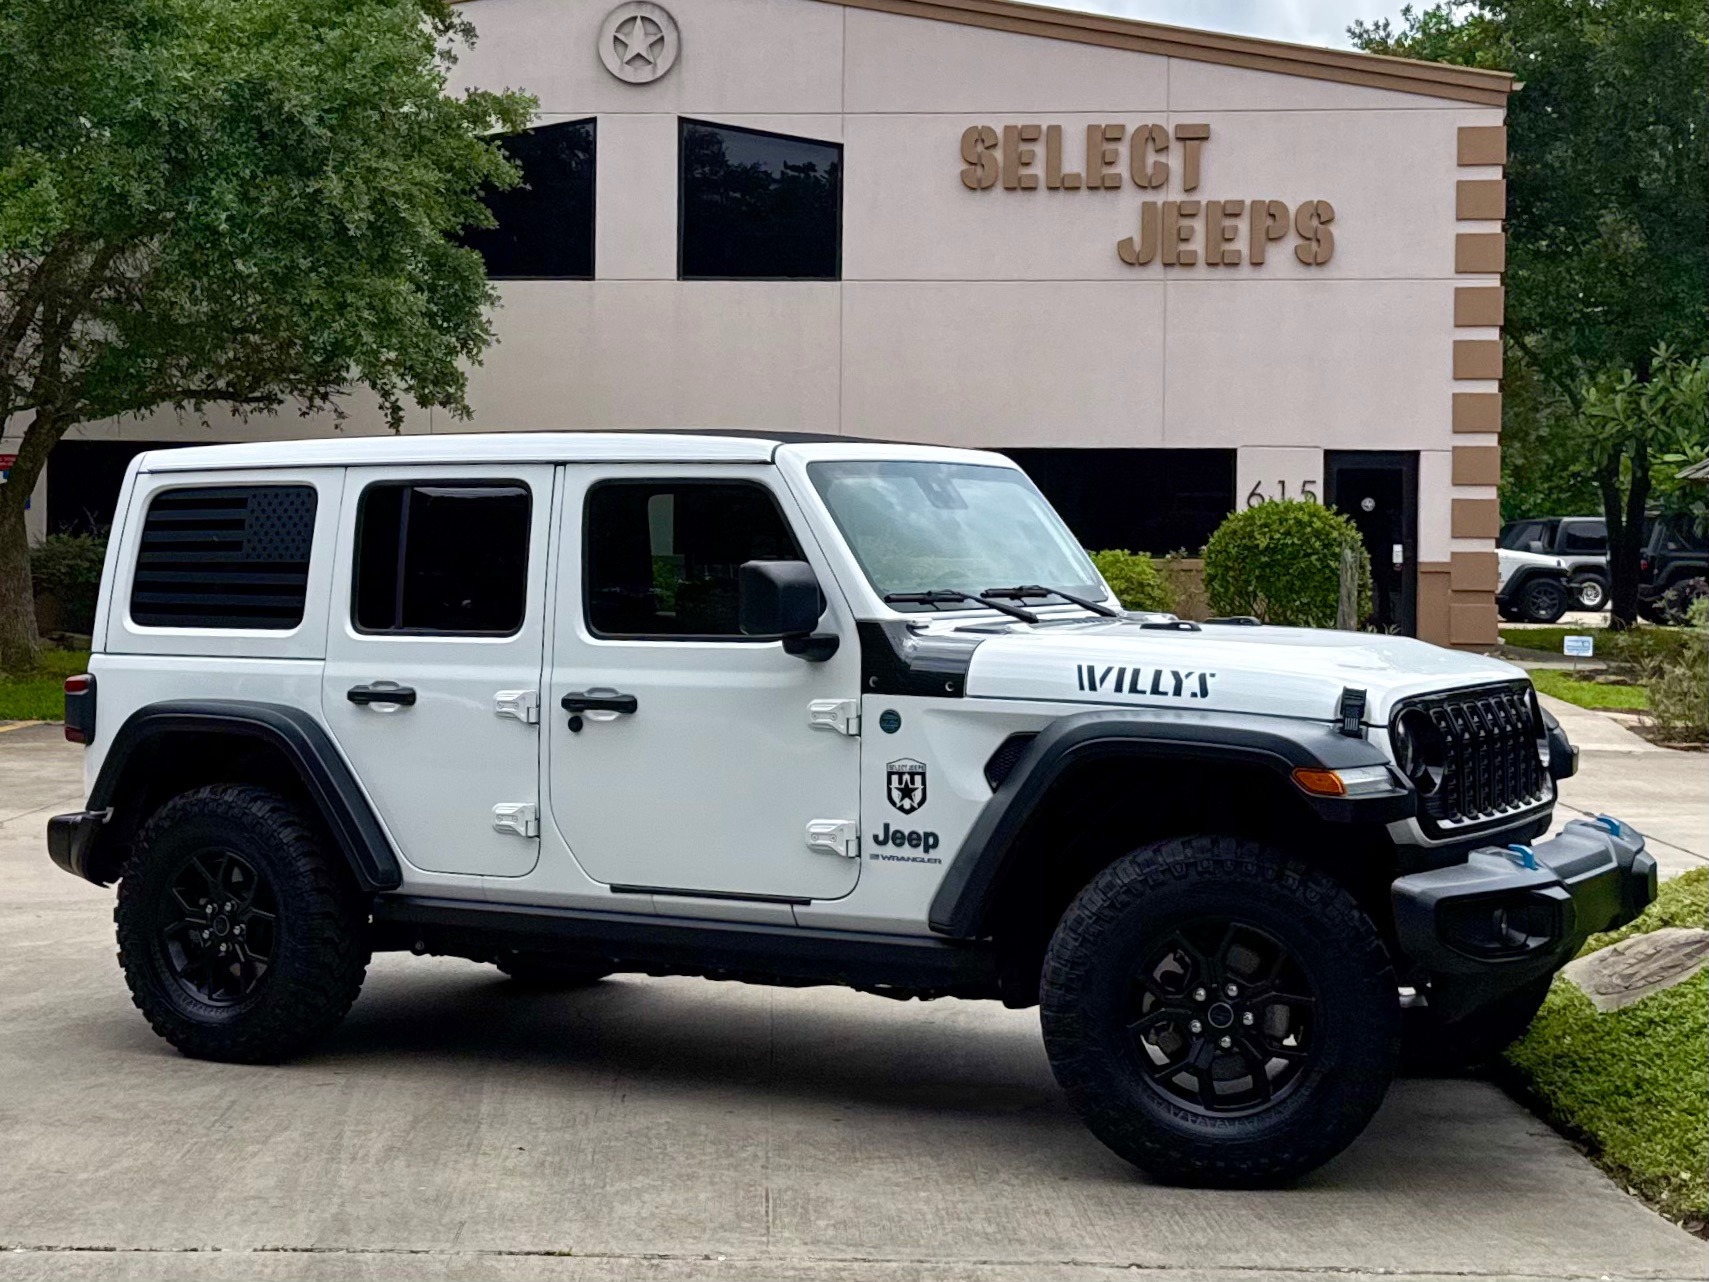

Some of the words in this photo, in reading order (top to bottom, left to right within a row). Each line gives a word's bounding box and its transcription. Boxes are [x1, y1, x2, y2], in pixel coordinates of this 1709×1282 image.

[960, 123, 1211, 192] SELECT
[1117, 199, 1336, 266] JEEPS
[1077, 664, 1217, 699] WILLYS
[872, 822, 940, 854] Jeep
[880, 854, 942, 864] WRANGLER
